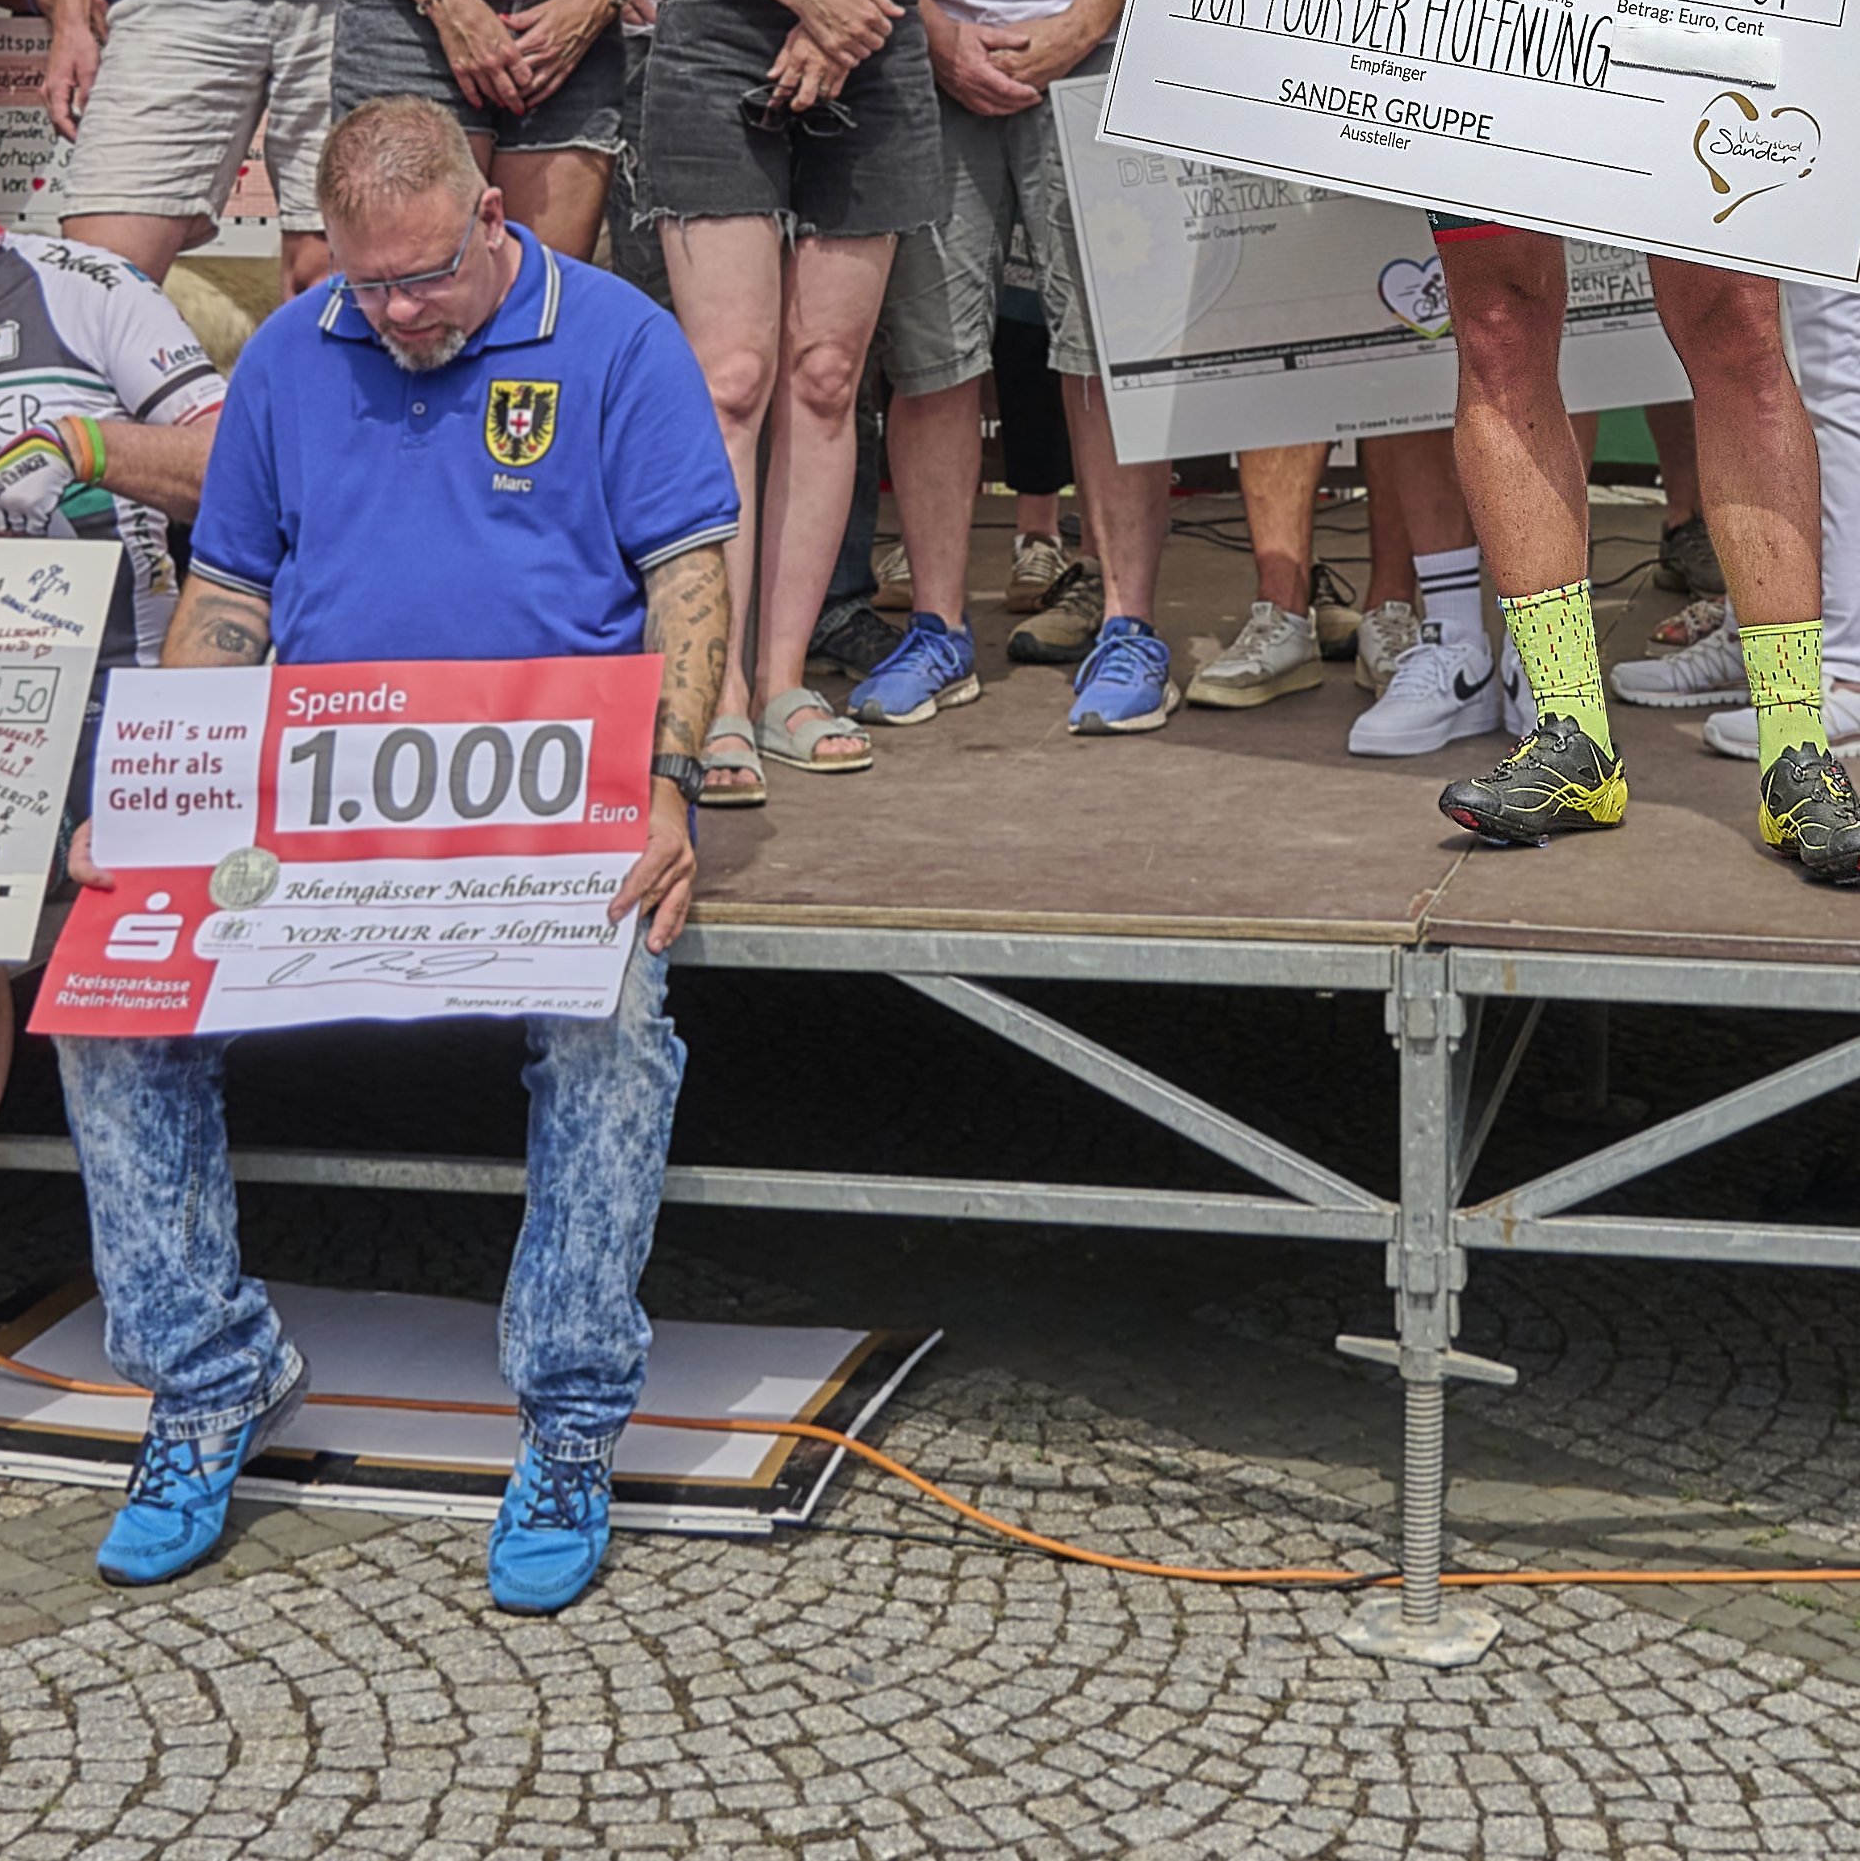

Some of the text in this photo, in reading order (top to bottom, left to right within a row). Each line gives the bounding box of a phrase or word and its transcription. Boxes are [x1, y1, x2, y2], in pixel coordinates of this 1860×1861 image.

[1678, 8, 1720, 32] Euro,
[1725, 15, 1765, 37] Cent
[1350, 53, 1428, 82] Empfänger
[1279, 78, 1494, 141] SANDER GRUPPE
[1340, 123, 1411, 151] Aussteller
[1709, 128, 1798, 164] Sander
[1117, 154, 1168, 187] DE
[1184, 181, 1289, 219] VOR-TOUR
[491, 472, 533, 495] Marc
[286, 683, 408, 722] Spende
[206, 724, 248, 741] um
[110, 751, 224, 776] mehr als
[289, 722, 586, 827] 1.000
[109, 786, 244, 815] Geld geht.
[588, 803, 639, 824] Euro
[285, 877, 443, 906] Rheingässer
[281, 919, 619, 948] VOR-TOUR der Hoffnung
[64, 973, 191, 994] Kreissparkasse
[54, 990, 191, 1011] Rhein-Hunsrück
